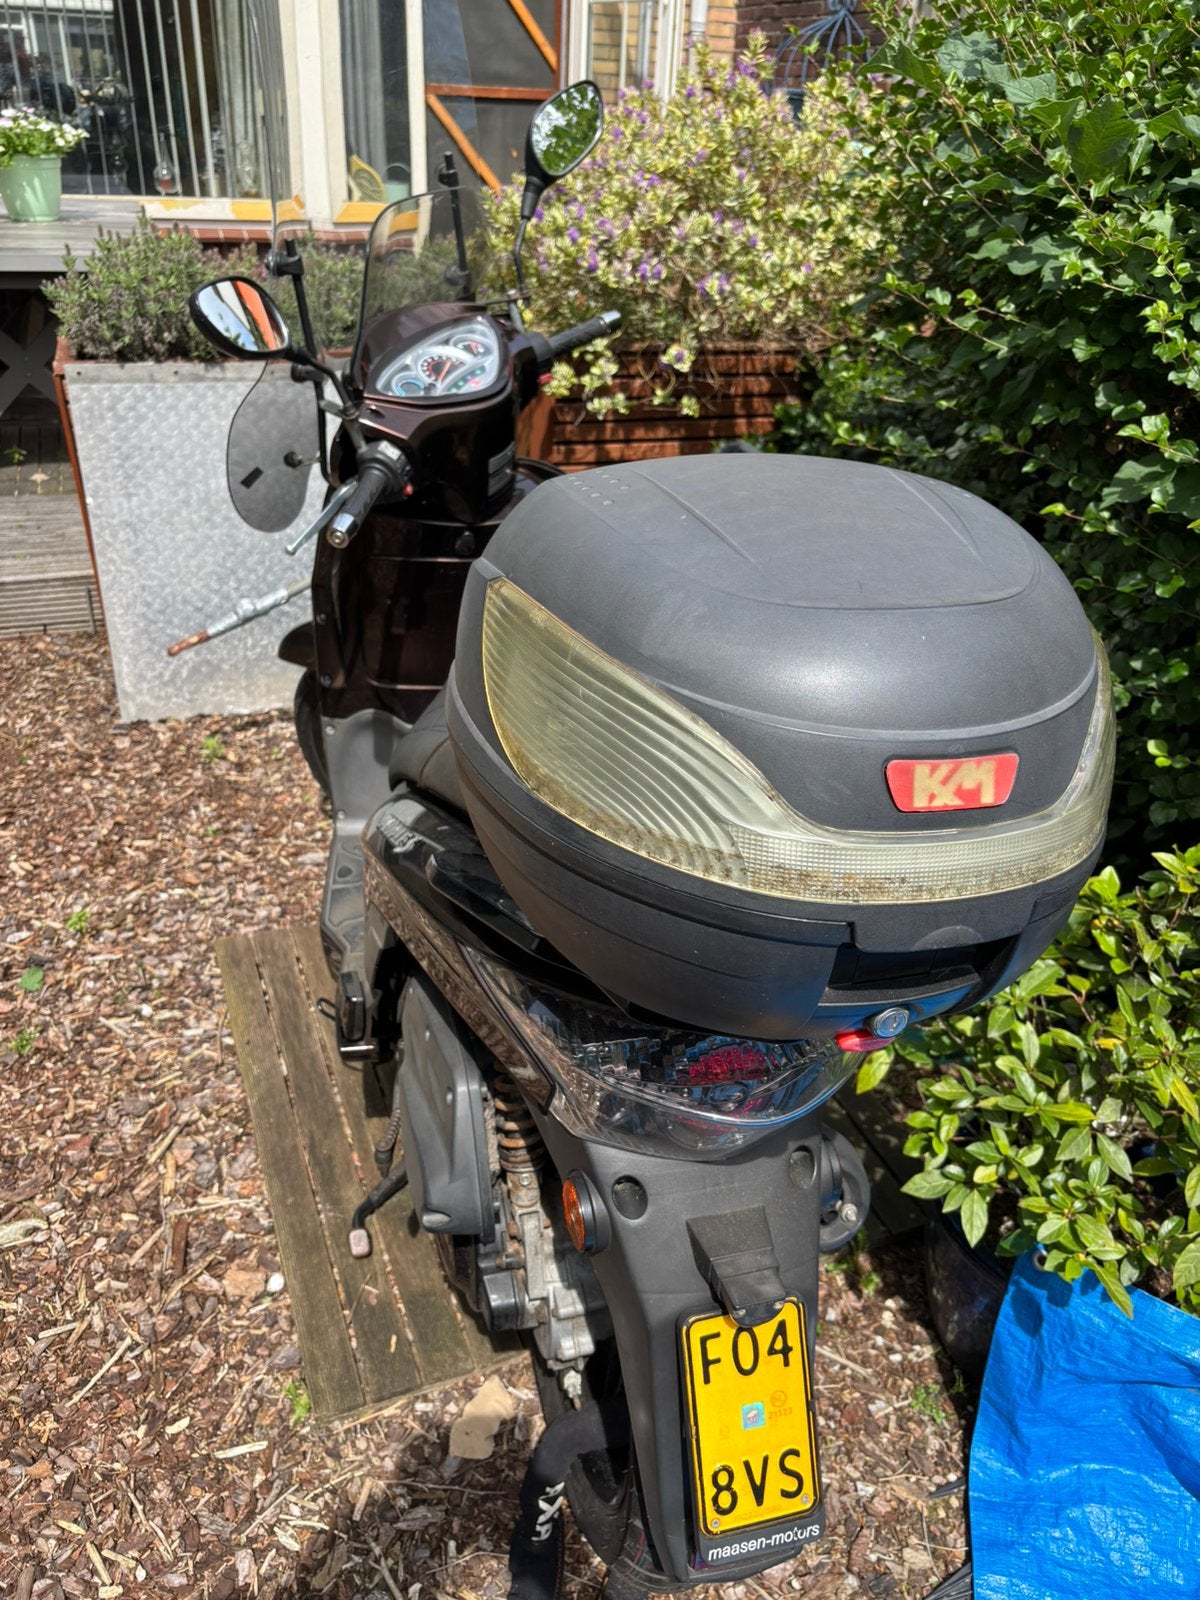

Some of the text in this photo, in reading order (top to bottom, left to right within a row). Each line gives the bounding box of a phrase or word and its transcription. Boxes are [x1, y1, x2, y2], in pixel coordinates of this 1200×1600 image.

[530, 1481, 565, 1541] AXA
[711, 1448, 804, 1516] 8VS
[707, 1524, 820, 1561] maasen-motors
